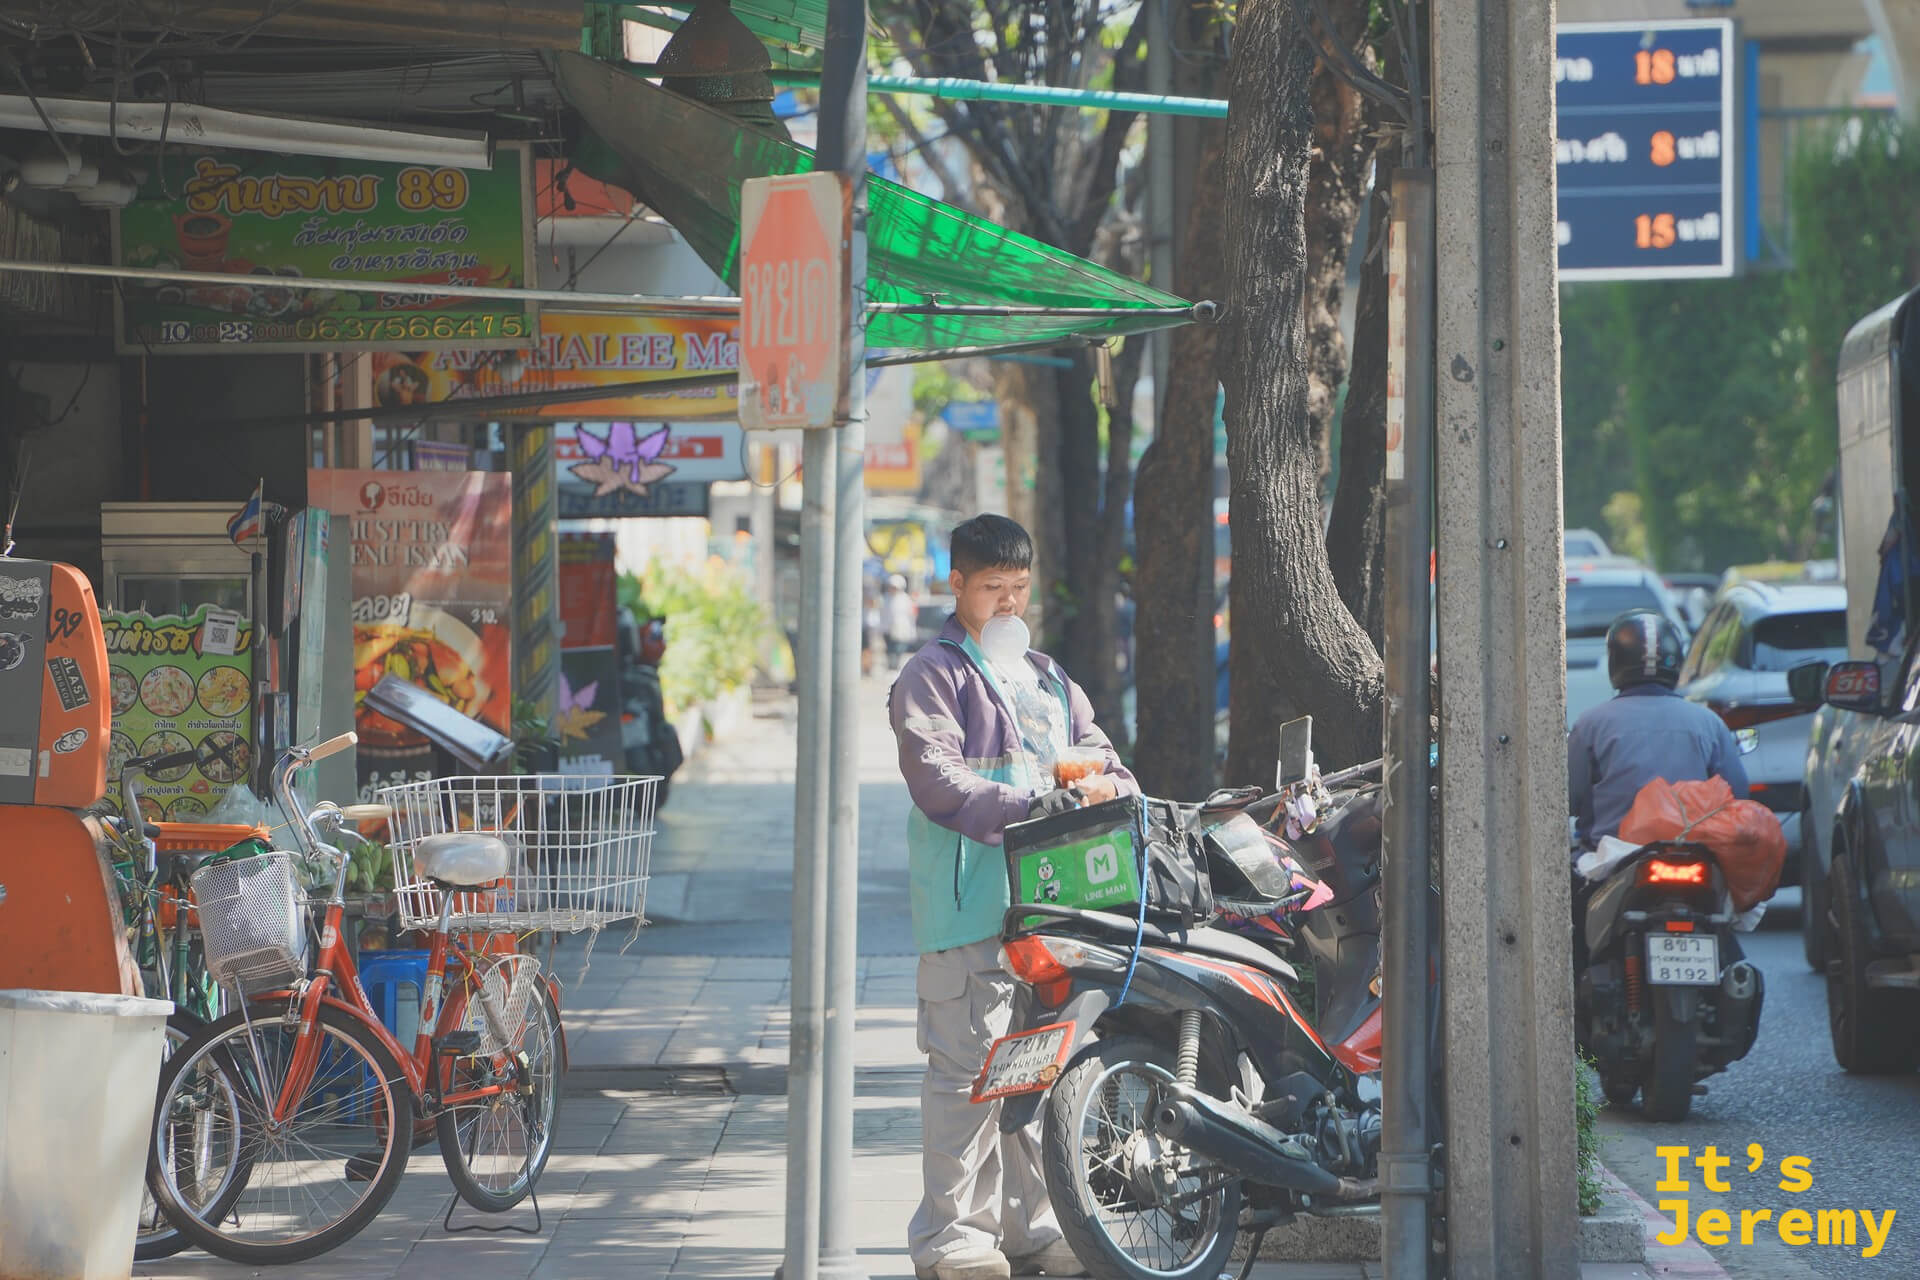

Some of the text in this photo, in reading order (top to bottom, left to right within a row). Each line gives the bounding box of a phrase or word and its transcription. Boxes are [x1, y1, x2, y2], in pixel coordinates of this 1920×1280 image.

[184, 157, 469, 217] ร้านลาบ 89
[330, 247, 478, 272] อาหารอีสาน
[351, 543, 400, 566] ENU
[62, 657, 88, 704] BLAST
[1105, 883, 1127, 897] MAN
[1660, 968, 1707, 981] 8192
